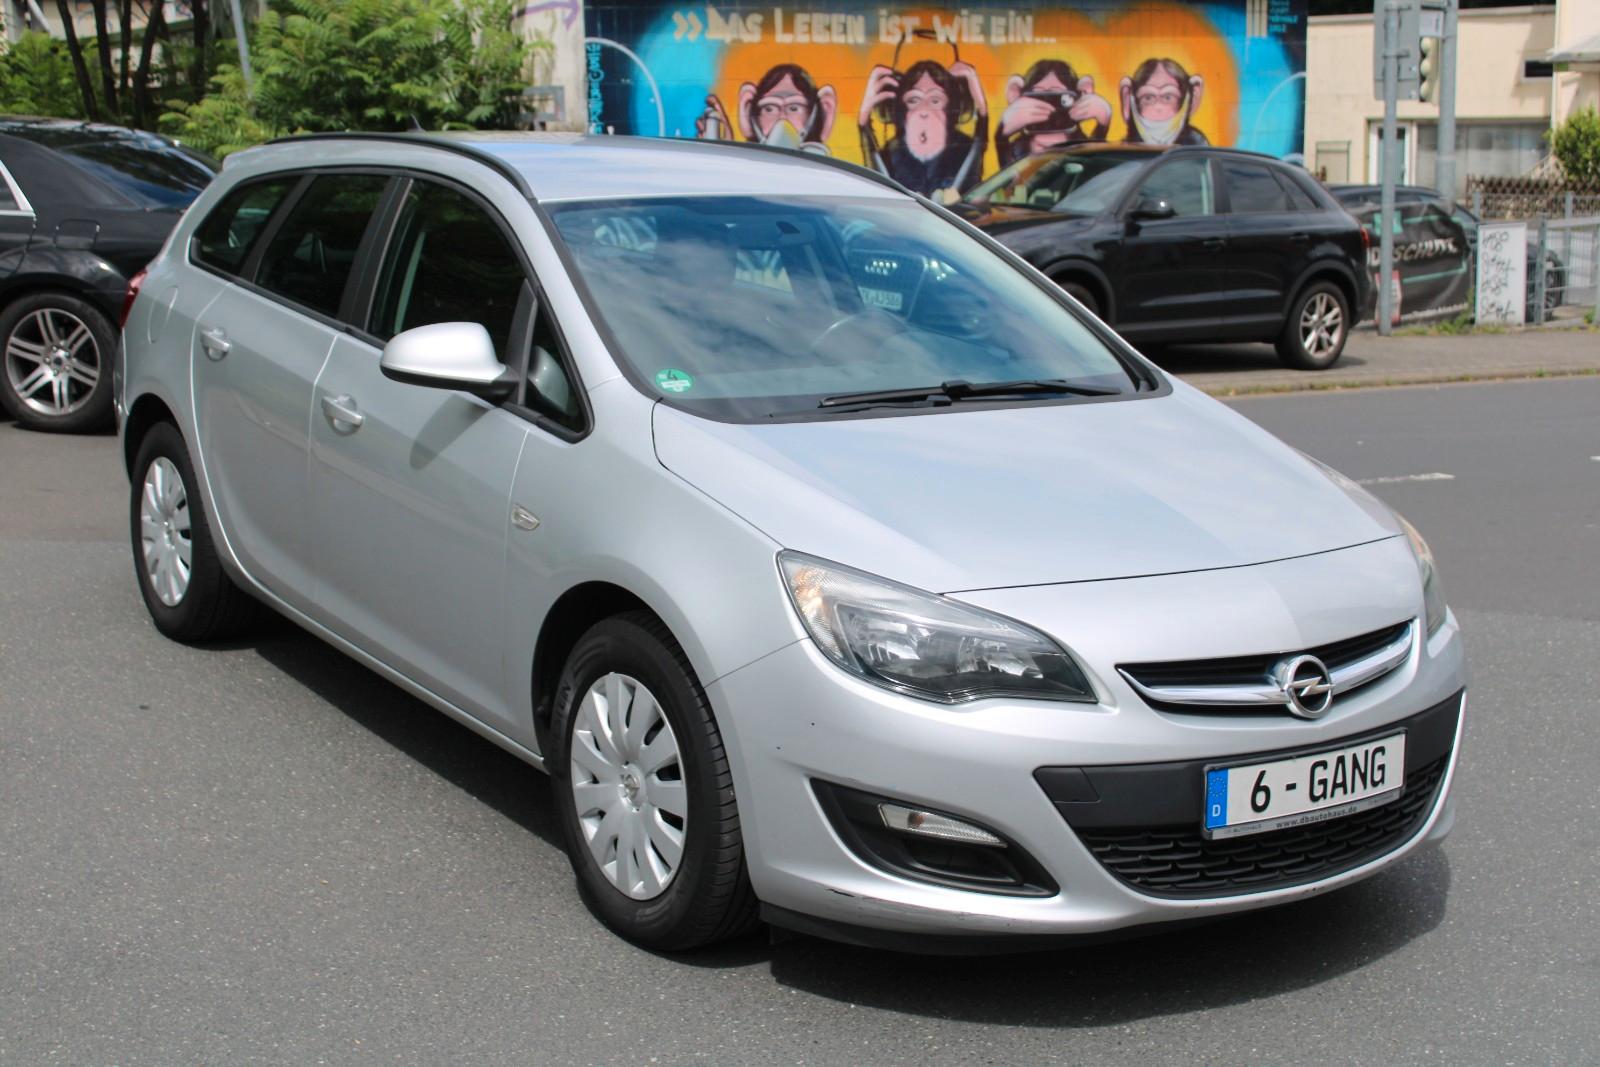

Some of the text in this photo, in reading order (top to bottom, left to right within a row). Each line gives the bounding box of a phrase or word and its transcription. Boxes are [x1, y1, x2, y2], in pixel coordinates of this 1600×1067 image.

[773, 7, 865, 44] LEBEN
[667, 370, 678, 380] 4
[1251, 770, 1271, 812] 6
[1309, 746, 1386, 802] GANG
[1212, 805, 1221, 817] D
[1276, 806, 1357, 828] www.dbautohaus.de
